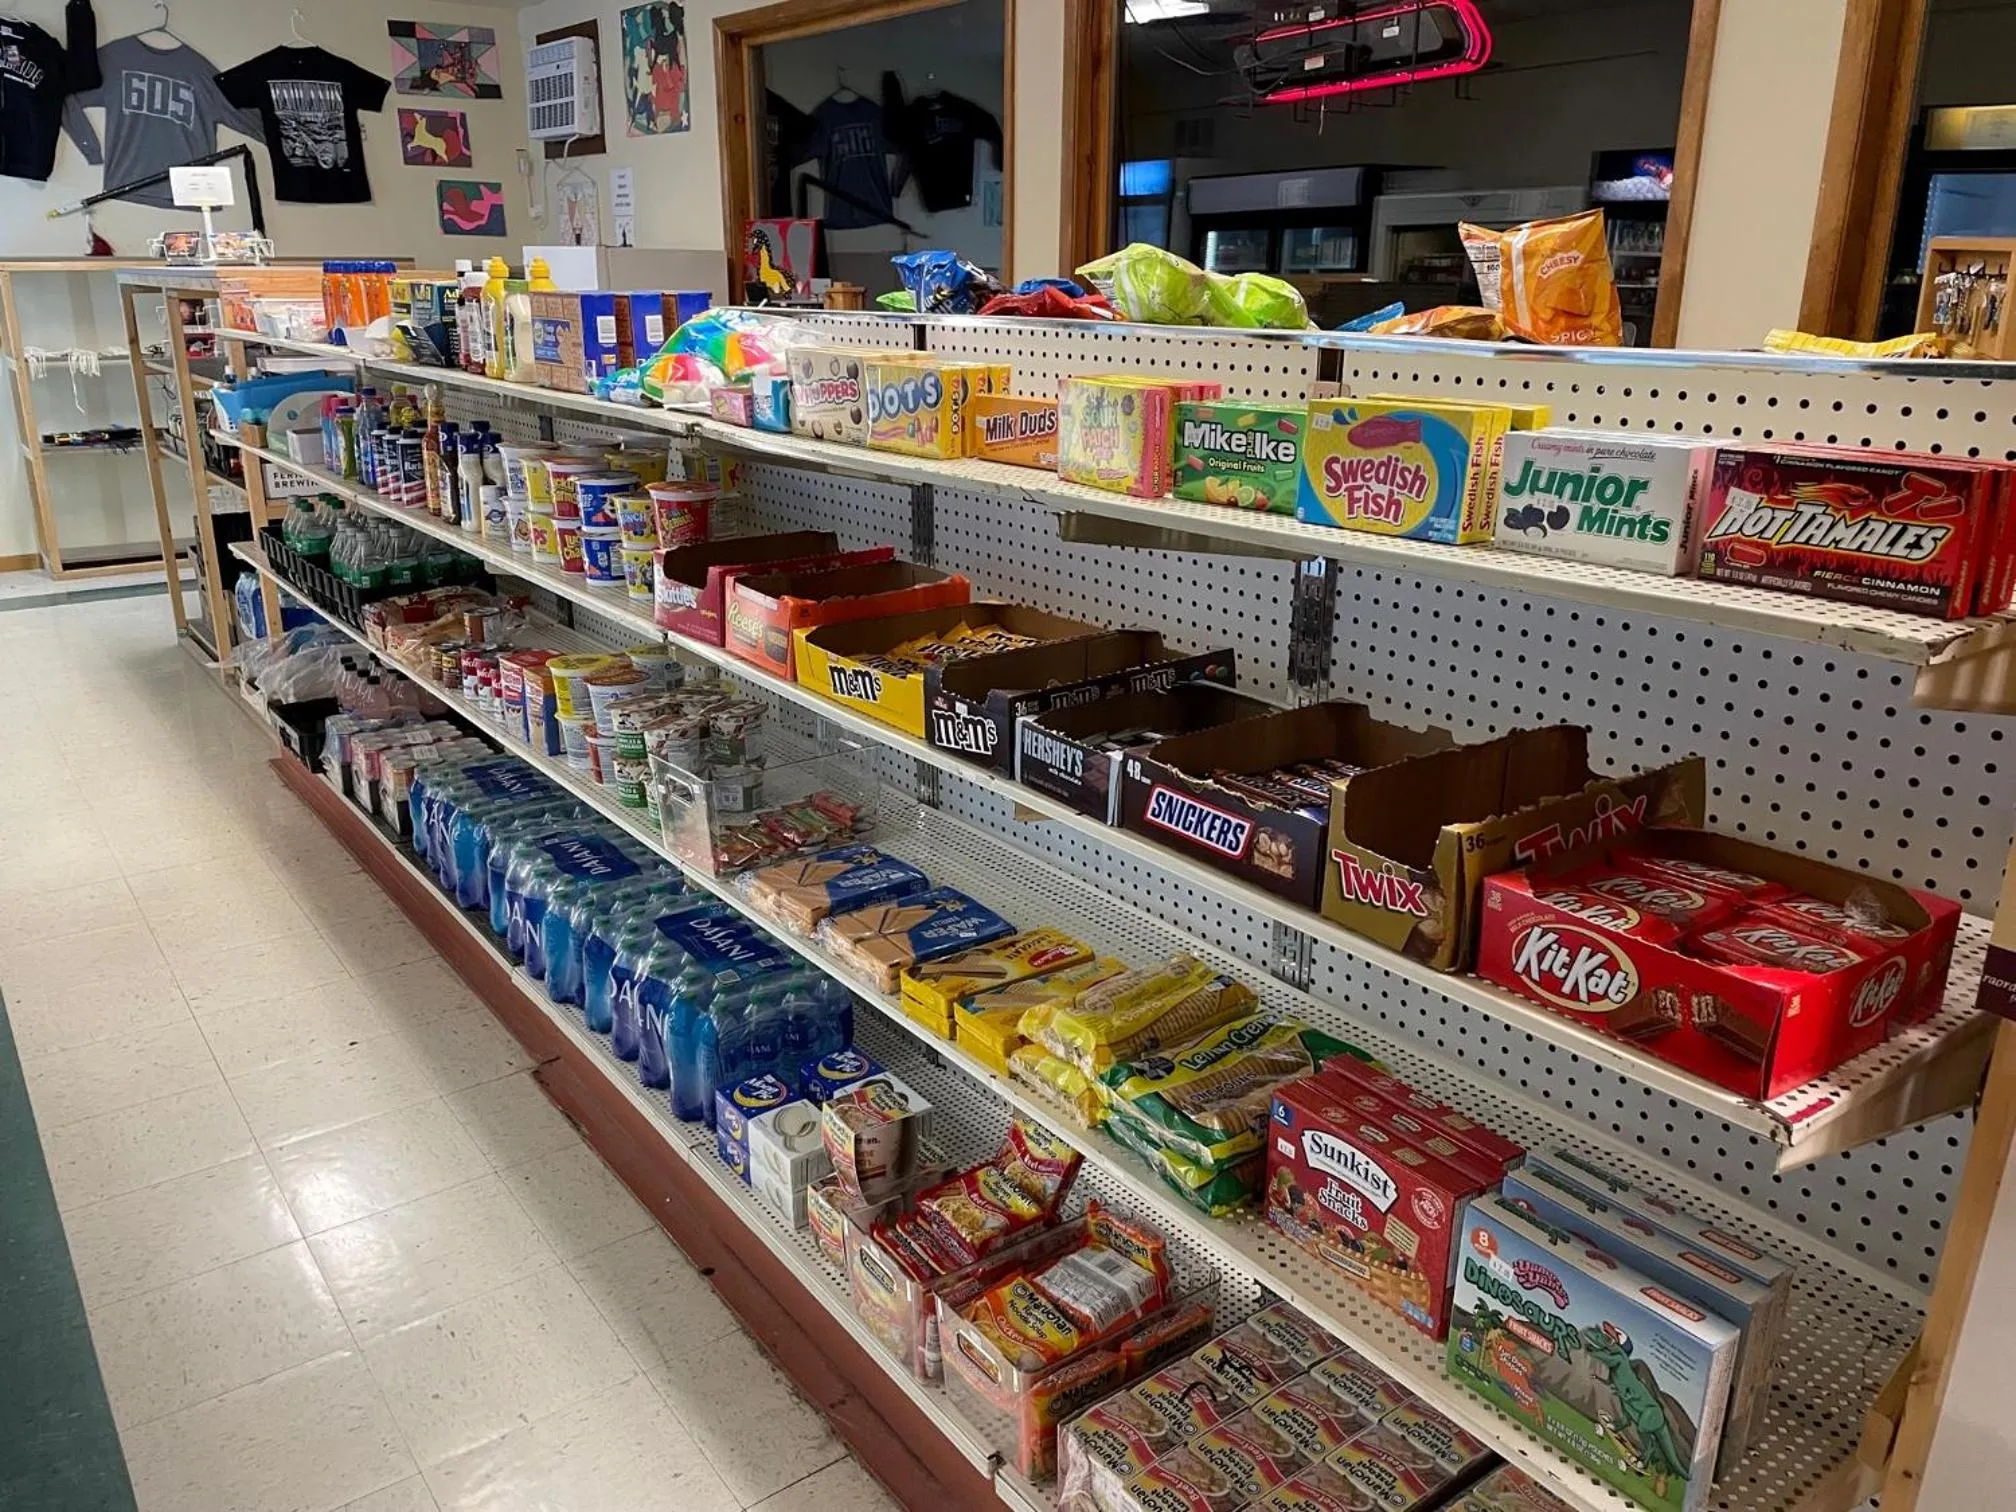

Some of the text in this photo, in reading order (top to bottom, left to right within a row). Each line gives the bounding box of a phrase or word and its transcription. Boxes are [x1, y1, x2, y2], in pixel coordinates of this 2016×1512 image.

[123, 71, 194, 125] 605
[1540, 254, 1581, 276] CHEESY
[869, 375, 939, 419] DOTS
[985, 409, 1056, 442] Milk Duds
[1183, 421, 1247, 453] Mike
[1255, 432, 1295, 463] Ike
[1208, 457, 1265, 473] Original Fruits
[1615, 447, 1657, 460] chocolate
[274, 480, 319, 488] BREWIN
[1324, 455, 1429, 499] Swedish
[1462, 436, 1484, 533] Swedish Fish
[1480, 436, 1503, 531] Swedish Fish
[1504, 459, 1650, 508] Junior
[1344, 483, 1404, 524] Fish
[1577, 504, 1672, 544] Mints
[1680, 503, 1694, 553] Junior
[1778, 501, 1951, 560] TAMALES
[1862, 577, 1941, 596] CINNAMON
[1023, 727, 1084, 779] HERSHEY'S
[1126, 758, 1142, 781] 48
[1150, 790, 1247, 852] SNICKERS
[1465, 833, 1485, 852] 36
[689, 917, 756, 962] DASANI
[1278, 1104, 1286, 1119] 6
[1309, 1132, 1392, 1202] Sunkist
[1319, 1189, 1368, 1230] Snacks
[1327, 1178, 1362, 1212] Fruit
[1479, 1230, 1489, 1247] 8
[992, 1313, 1027, 1344] Chicken
[1005, 1299, 1035, 1325] Noodle
[1021, 1304, 1046, 1326] Ramen
[1022, 1291, 1075, 1336] Maruchan
[1320, 1366, 1372, 1409] Maruchan
[1135, 1387, 1187, 1430] Maruchan
[1155, 1390, 1191, 1421] Instant
[1289, 1406, 1320, 1432] Lunch
[1304, 1401, 1328, 1422] Beef
[1259, 1404, 1314, 1449] Maruchan
[1279, 1407, 1318, 1439] Instant
[1391, 1414, 1449, 1461] Maruchan
[1068, 1425, 1122, 1470] Maruchan
[1215, 1446, 1255, 1479] Instant
[1240, 1440, 1266, 1462] Beef
[1379, 1450, 1406, 1474] Beef
[1193, 1441, 1250, 1489] Maruchan
[1334, 1454, 1392, 1500] Maruchan
[1356, 1458, 1396, 1491] Instant
[1365, 1456, 1398, 1484] Lunch
[1126, 1482, 1166, 1512] ruchan
[1148, 1487, 1183, 1512] nstant
[1175, 1480, 1201, 1502] Beef
